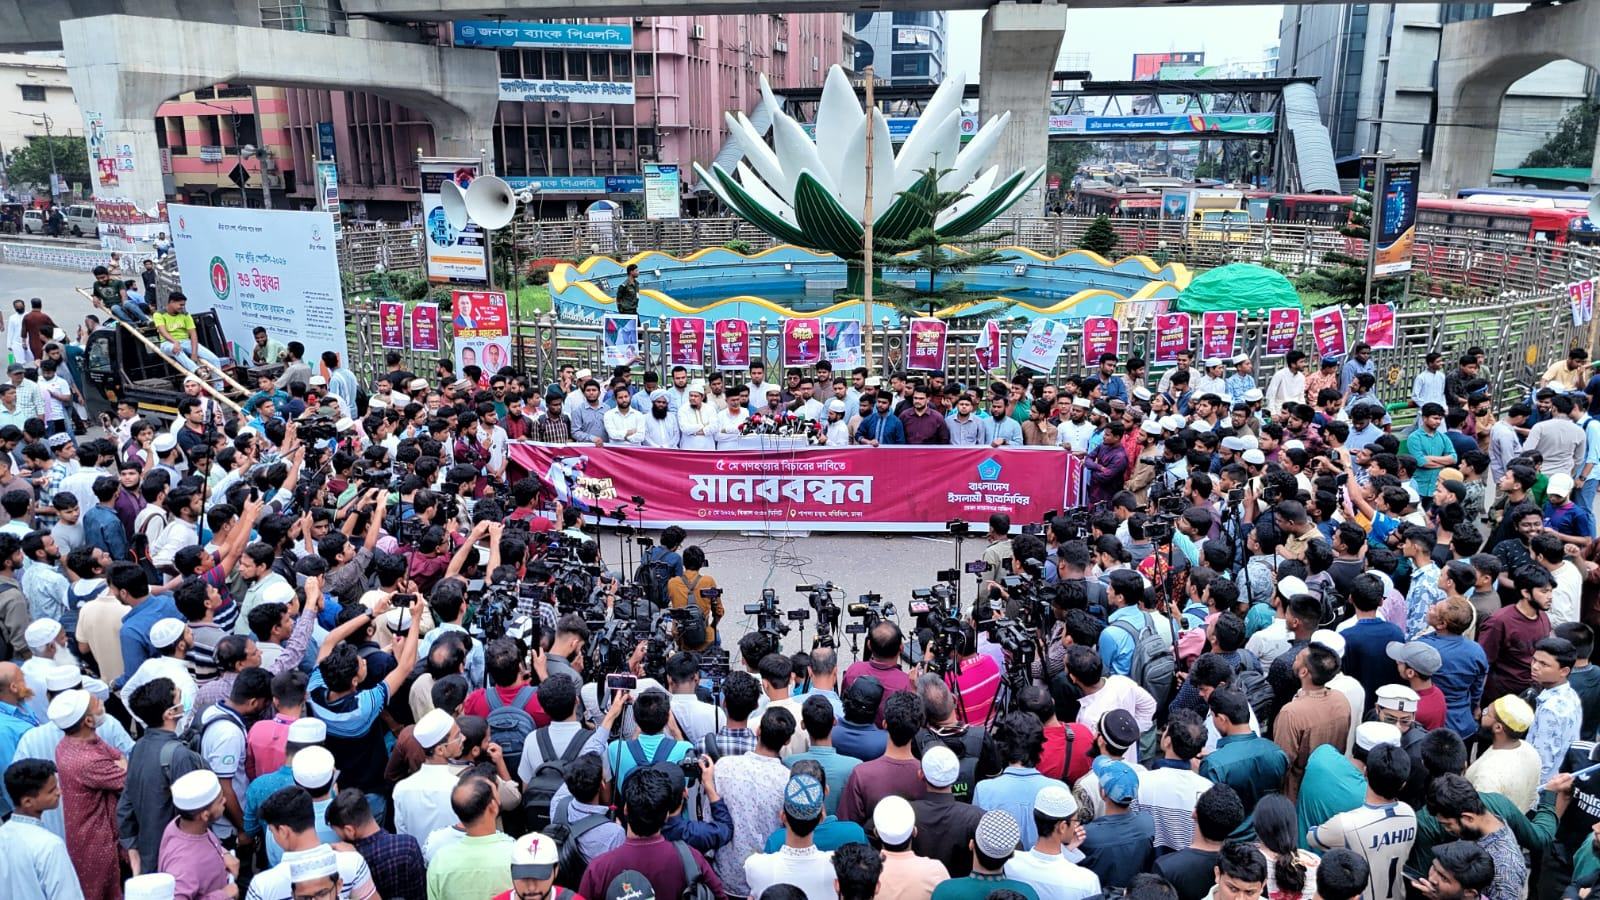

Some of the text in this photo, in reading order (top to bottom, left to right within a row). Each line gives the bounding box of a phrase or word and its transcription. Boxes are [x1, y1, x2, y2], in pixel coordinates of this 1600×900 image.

[478, 26, 624, 41] জনতা ব্যাংক পিএলসি.
[716, 460, 846, 471] ৫ মে গণহত্যার বিচারের দাবিতে
[688, 474, 874, 505] মানববন্ধন
[968, 482, 1010, 492] বাংলাদেশ
[948, 491, 1030, 506] ইসলামী ছাত্রশিবির
[1369, 827, 1415, 851] JAHID
